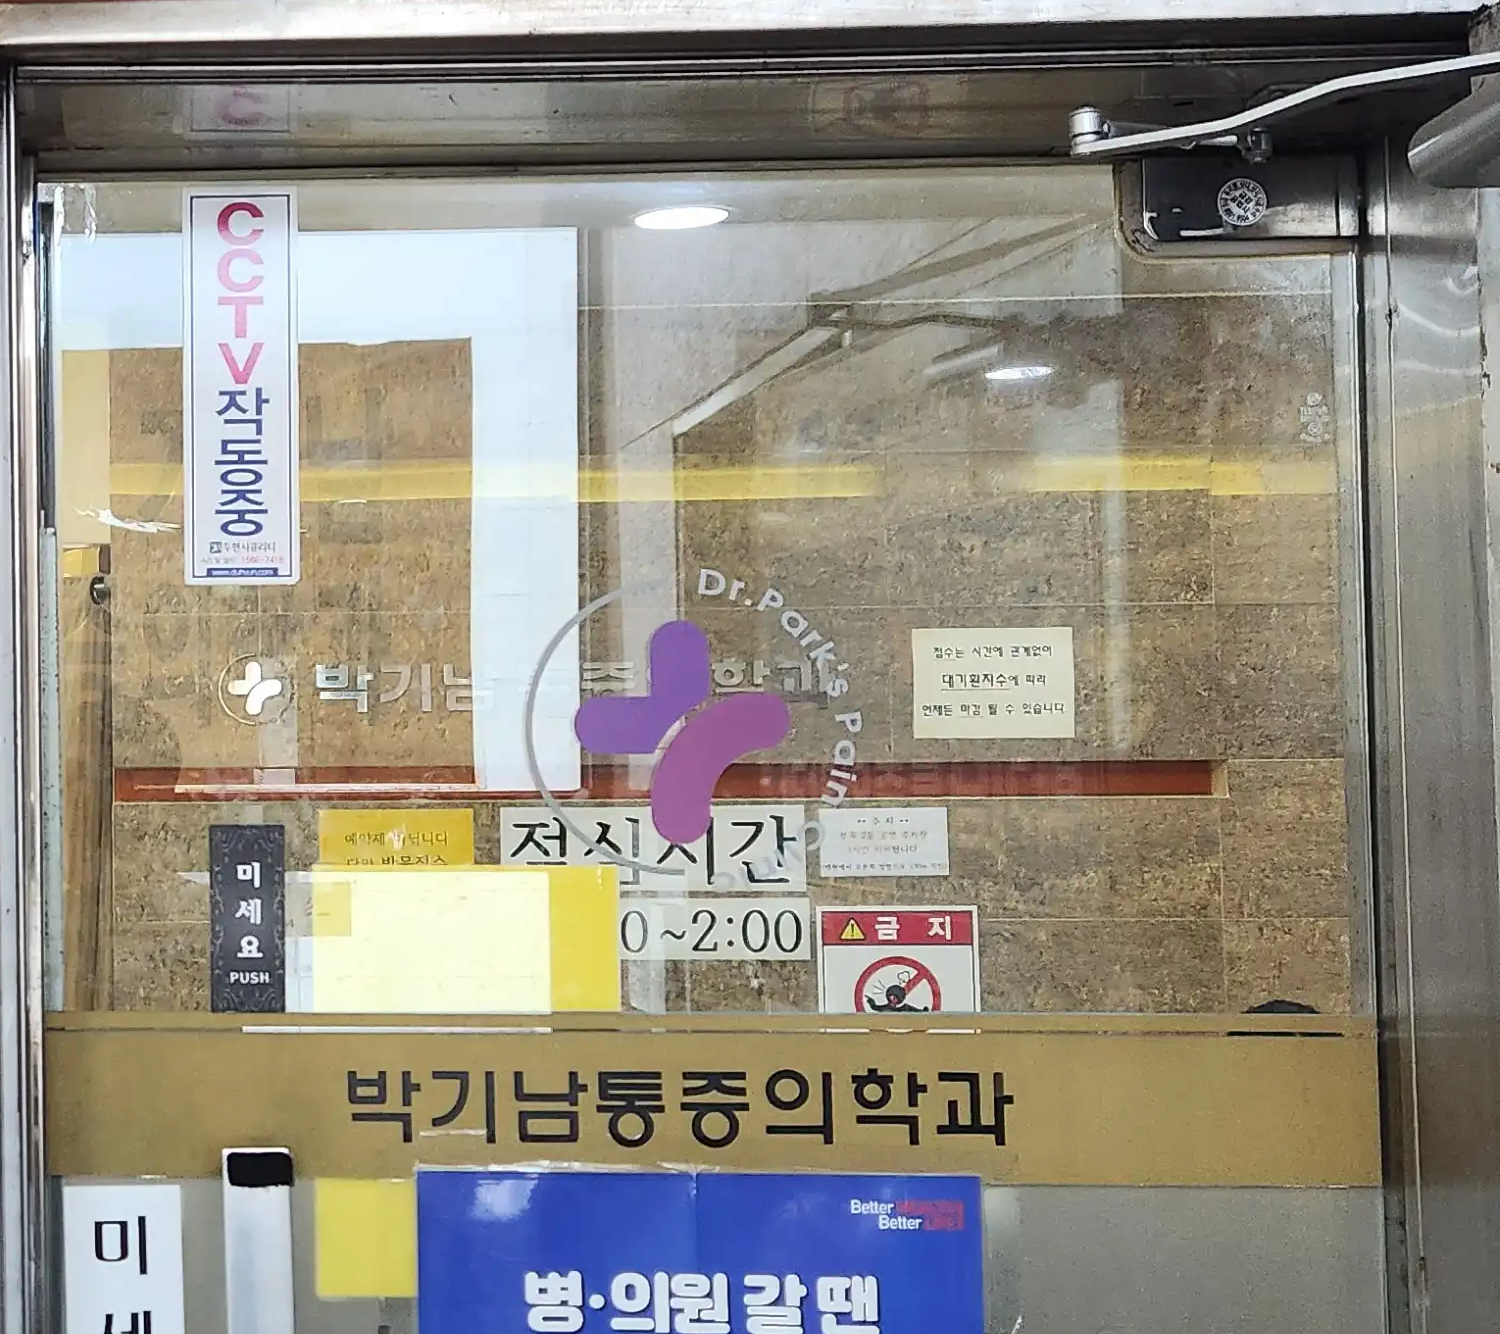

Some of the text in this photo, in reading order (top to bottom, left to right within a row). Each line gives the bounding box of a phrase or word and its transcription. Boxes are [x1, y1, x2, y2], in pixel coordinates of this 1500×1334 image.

[698, 568, 850, 698] Dr.Park's
[821, 711, 864, 807] Pain
[1005, 703, 1015, 715] 수
[235, 861, 263, 959] 미세요
[229, 971, 270, 985] PUSH
[347, 1068, 1015, 1149] 박기남통증의학과
[849, 1199, 895, 1215] Better
[878, 1214, 923, 1230] Better
